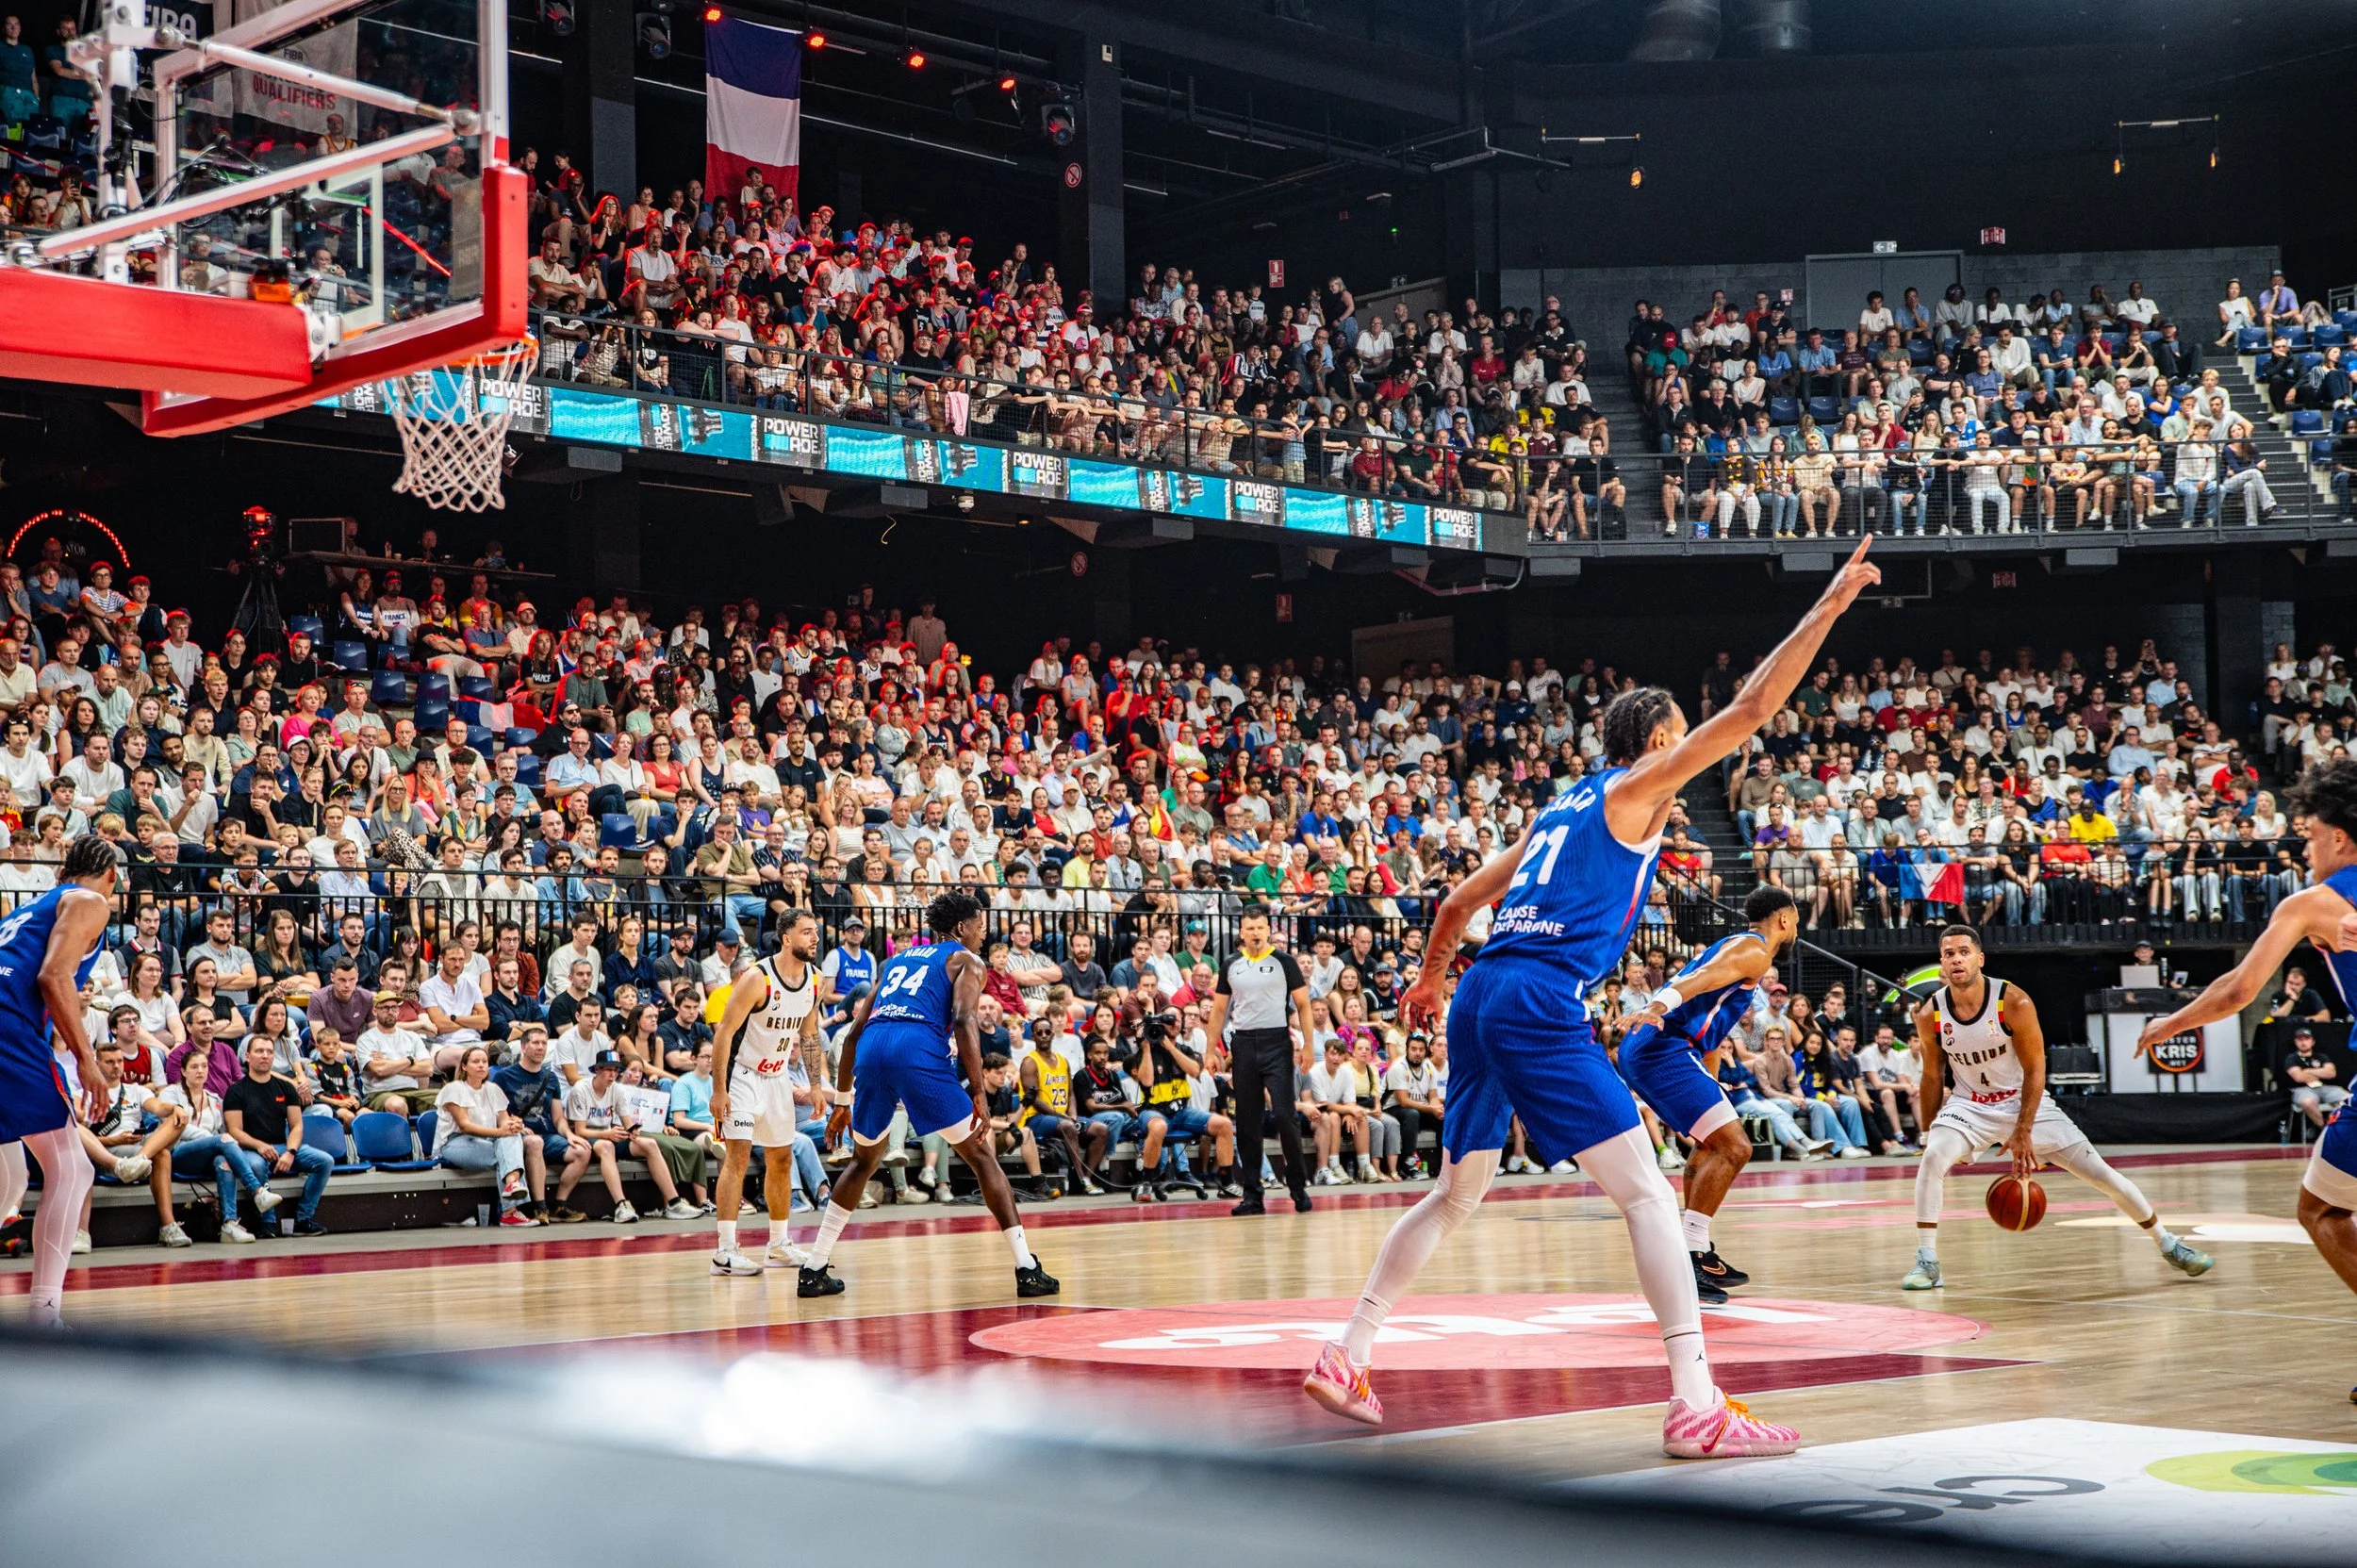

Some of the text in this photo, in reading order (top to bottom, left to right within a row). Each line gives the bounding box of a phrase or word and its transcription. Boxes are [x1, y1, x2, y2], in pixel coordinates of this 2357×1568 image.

[284, 48, 304, 61] FIBA
[253, 74, 337, 110] QUALIFIERS
[480, 378, 542, 402] POWER
[660, 404, 673, 451] POWER
[764, 417, 818, 439] POWER
[789, 437, 819, 454] ADE
[922, 439, 934, 483] POWER
[1014, 452, 1062, 470] POWER
[1036, 470, 1063, 486] ADE
[1235, 481, 1279, 499] POWER
[1256, 498, 1280, 513] ADE
[1434, 508, 1474, 525] POWER
[1453, 524, 1474, 537] ADE
[384, 613, 406, 621] FRANCE
[1509, 825, 1570, 891] 21
[846, 968, 869, 979] FRANCE
[880, 965, 930, 999] 34
[766, 1016, 806, 1030] BELGIU
[776, 1037, 790, 1052] 20
[2155, 1045, 2198, 1059] KRIS
[1981, 1072, 1989, 1087] 4
[1051, 1088, 1067, 1107] 23
